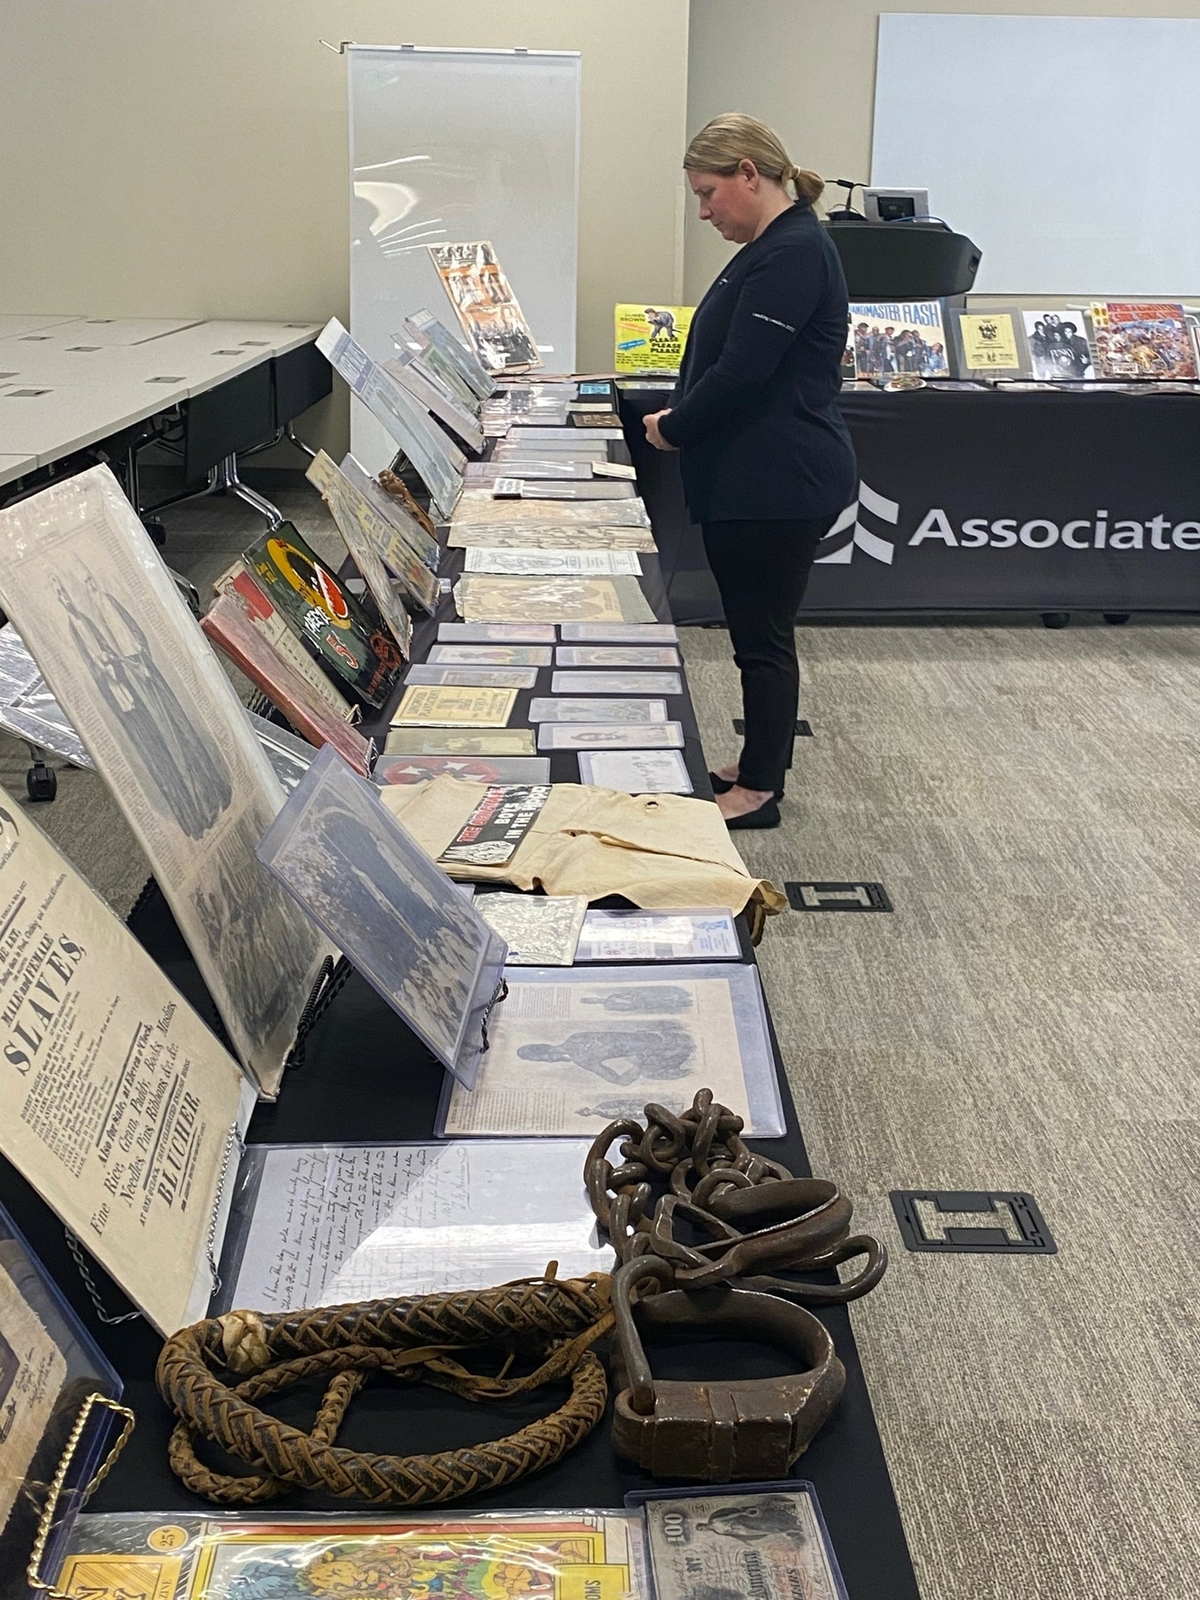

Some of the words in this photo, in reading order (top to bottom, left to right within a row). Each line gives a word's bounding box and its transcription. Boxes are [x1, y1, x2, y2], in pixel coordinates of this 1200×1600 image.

[849, 303, 901, 322] ANDMASTER
[903, 303, 941, 328] FLASH
[650, 347, 680, 355] PLEASE
[651, 342, 682, 350] PLEASE
[906, 508, 1200, 551] Associate
[493, 801, 521, 825] BOYS
[510, 811, 535, 829] THE
[456, 825, 483, 843] THE
[503, 828, 525, 839] IN
[5, 928, 21, 949] LET,
[25, 933, 54, 979] FEMALE
[19, 972, 33, 996] and
[1, 990, 24, 1028] MALE
[3, 933, 87, 1077] SLAVES,
[125, 1056, 141, 1088] Eleven
[122, 1084, 130, 1099] at
[112, 1101, 127, 1126] Sale,
[106, 1123, 118, 1142] for
[90, 1202, 110, 1237] Fine
[103, 1162, 125, 1196] Rice,
[118, 1118, 139, 1153] Gram,
[129, 1078, 151, 1116] Paddy,
[97, 1141, 112, 1168] Also
[157, 1091, 201, 1208] BLUCHER,
[119, 1155, 146, 1208] Needles,
[142, 1194, 152, 1213] ONE
[139, 1212, 147, 1227] AT
[662, 1511, 689, 1546] 100
